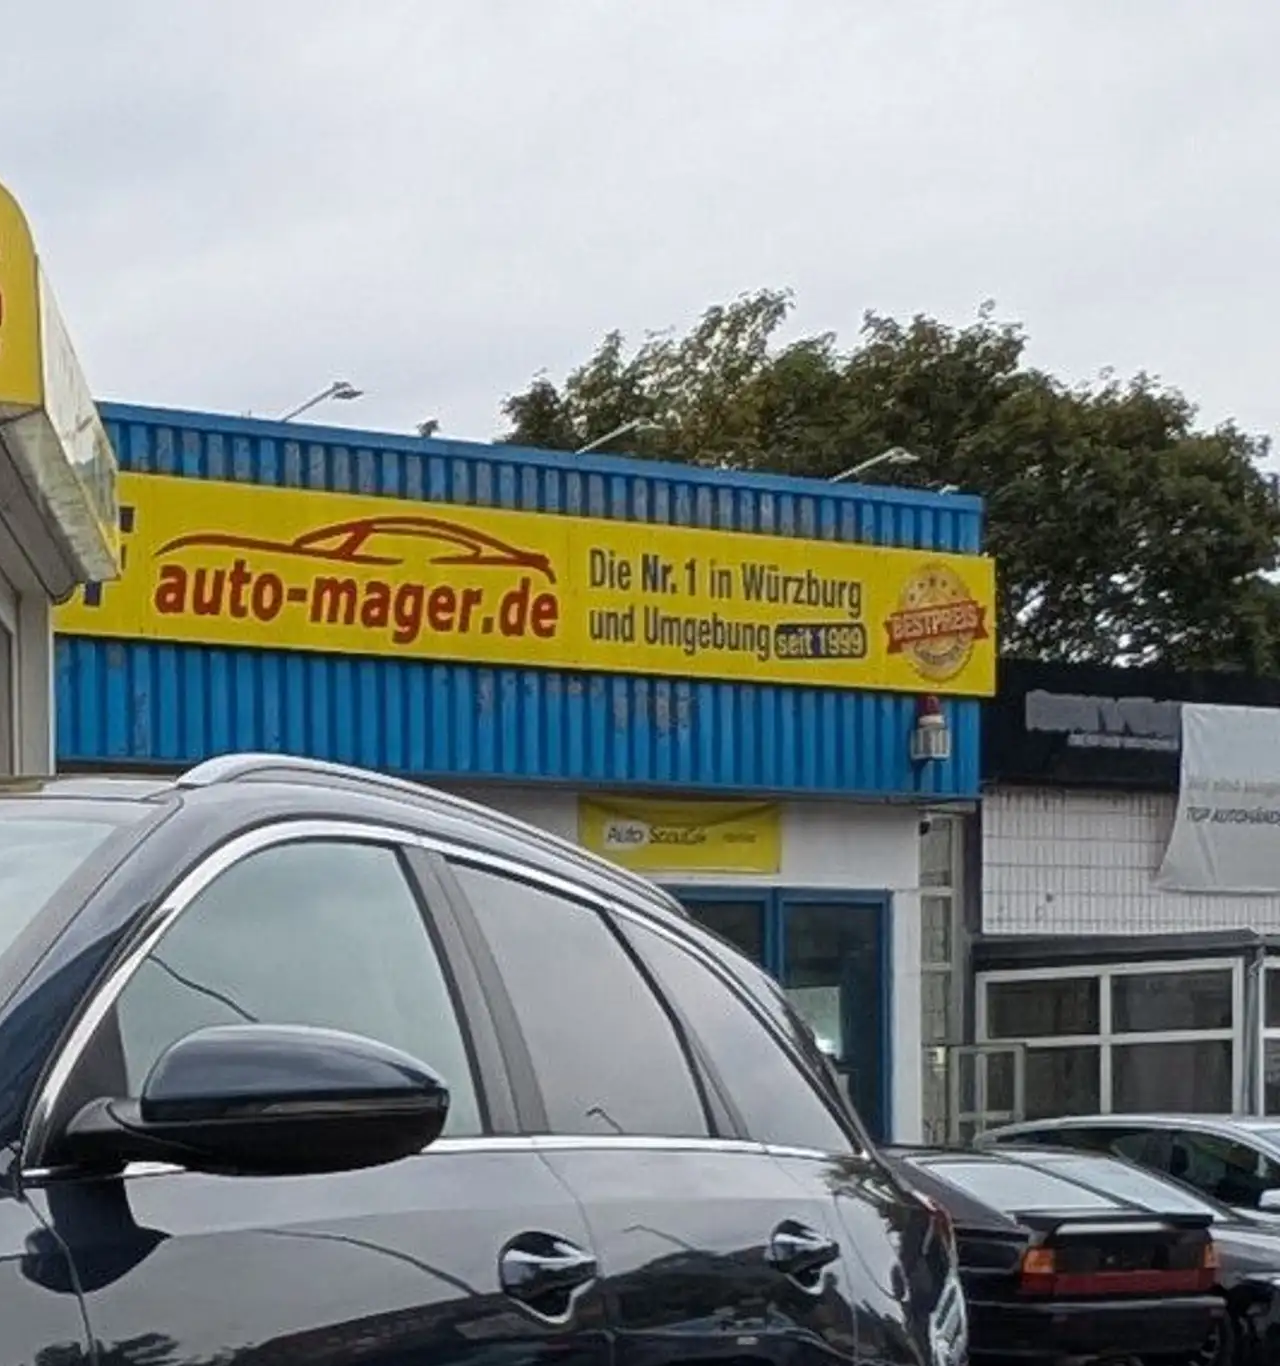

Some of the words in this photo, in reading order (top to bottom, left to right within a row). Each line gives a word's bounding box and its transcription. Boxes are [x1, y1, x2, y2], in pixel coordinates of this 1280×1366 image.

[153, 558, 559, 645] auto-mager.de
[590, 548, 631, 591] Die
[641, 553, 678, 595] Nr.
[684, 558, 697, 597] 1
[709, 558, 733, 599] in
[741, 561, 863, 619] Würzburg
[590, 606, 635, 643] und
[643, 604, 771, 662] Umgebung
[776, 627, 813, 656] seit
[818, 627, 863, 656] 1999
